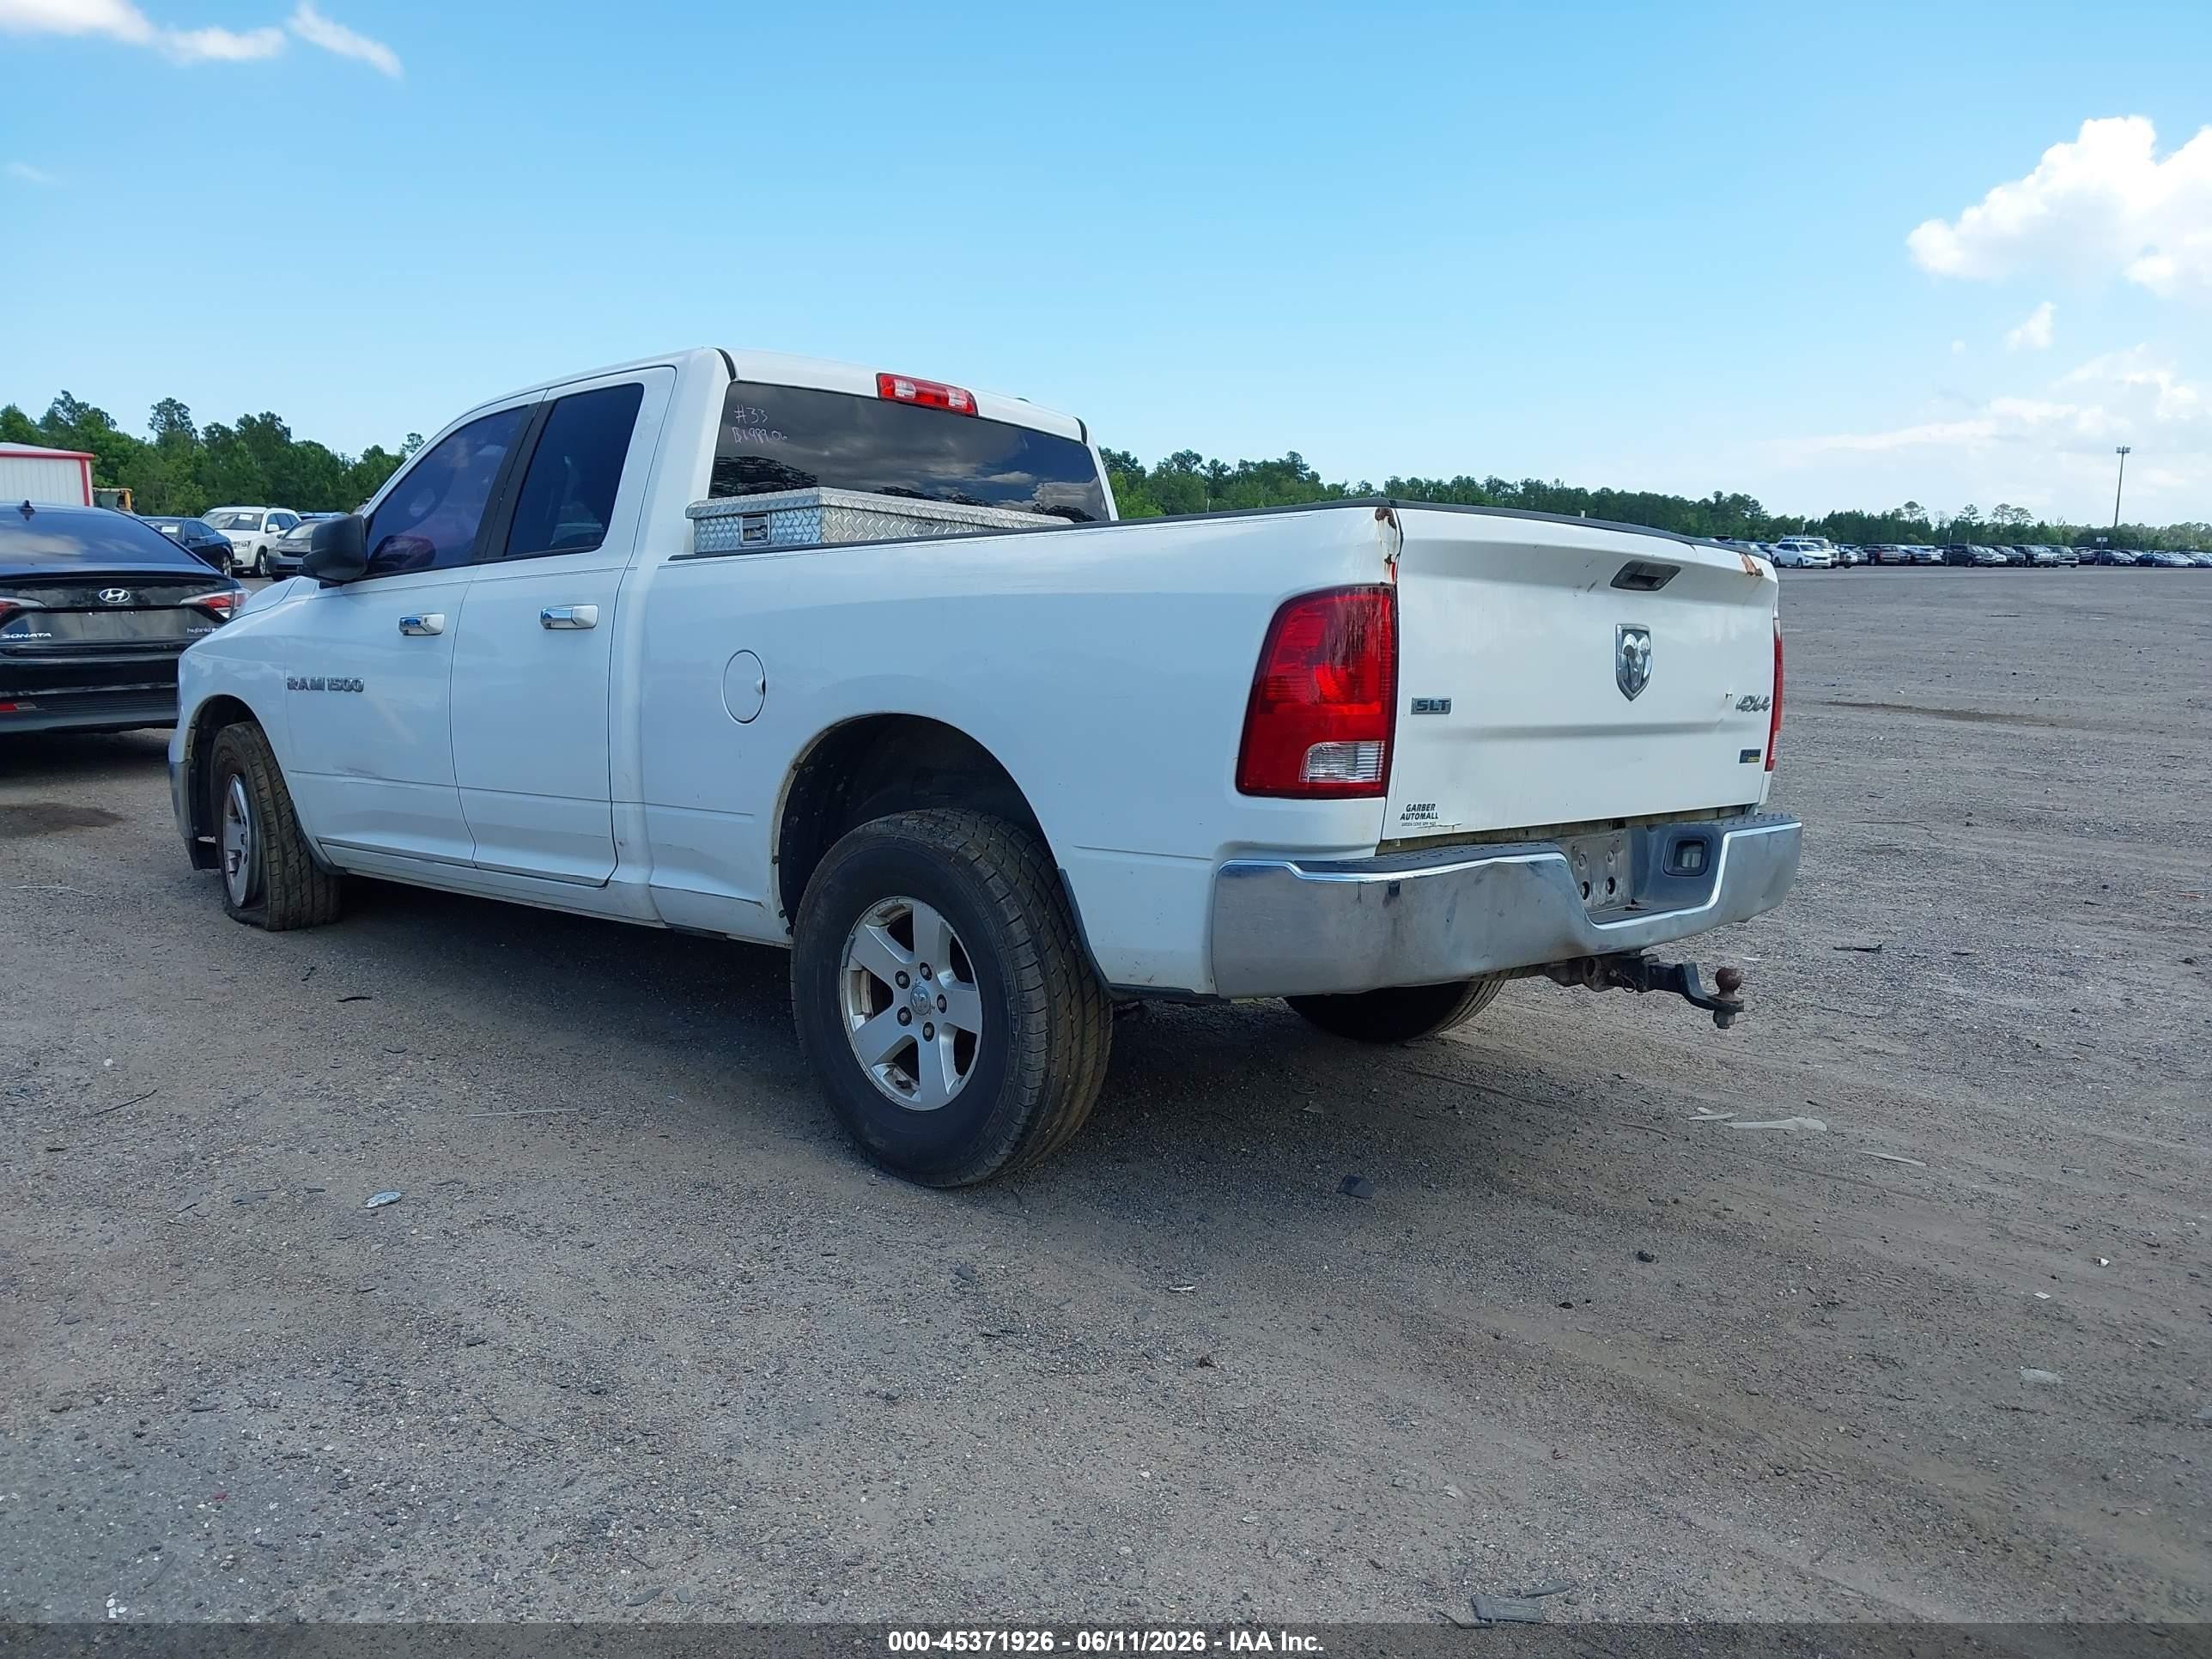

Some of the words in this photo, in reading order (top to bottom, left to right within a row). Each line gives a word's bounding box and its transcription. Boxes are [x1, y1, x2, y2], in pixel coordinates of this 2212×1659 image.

[733, 404, 769, 424] #33
[287, 677, 325, 691] RAM
[327, 677, 364, 692] 1500
[1415, 699, 1450, 711] SLT
[1406, 803, 1437, 812] GARBER
[1400, 811, 1439, 821] AUTOMALL
